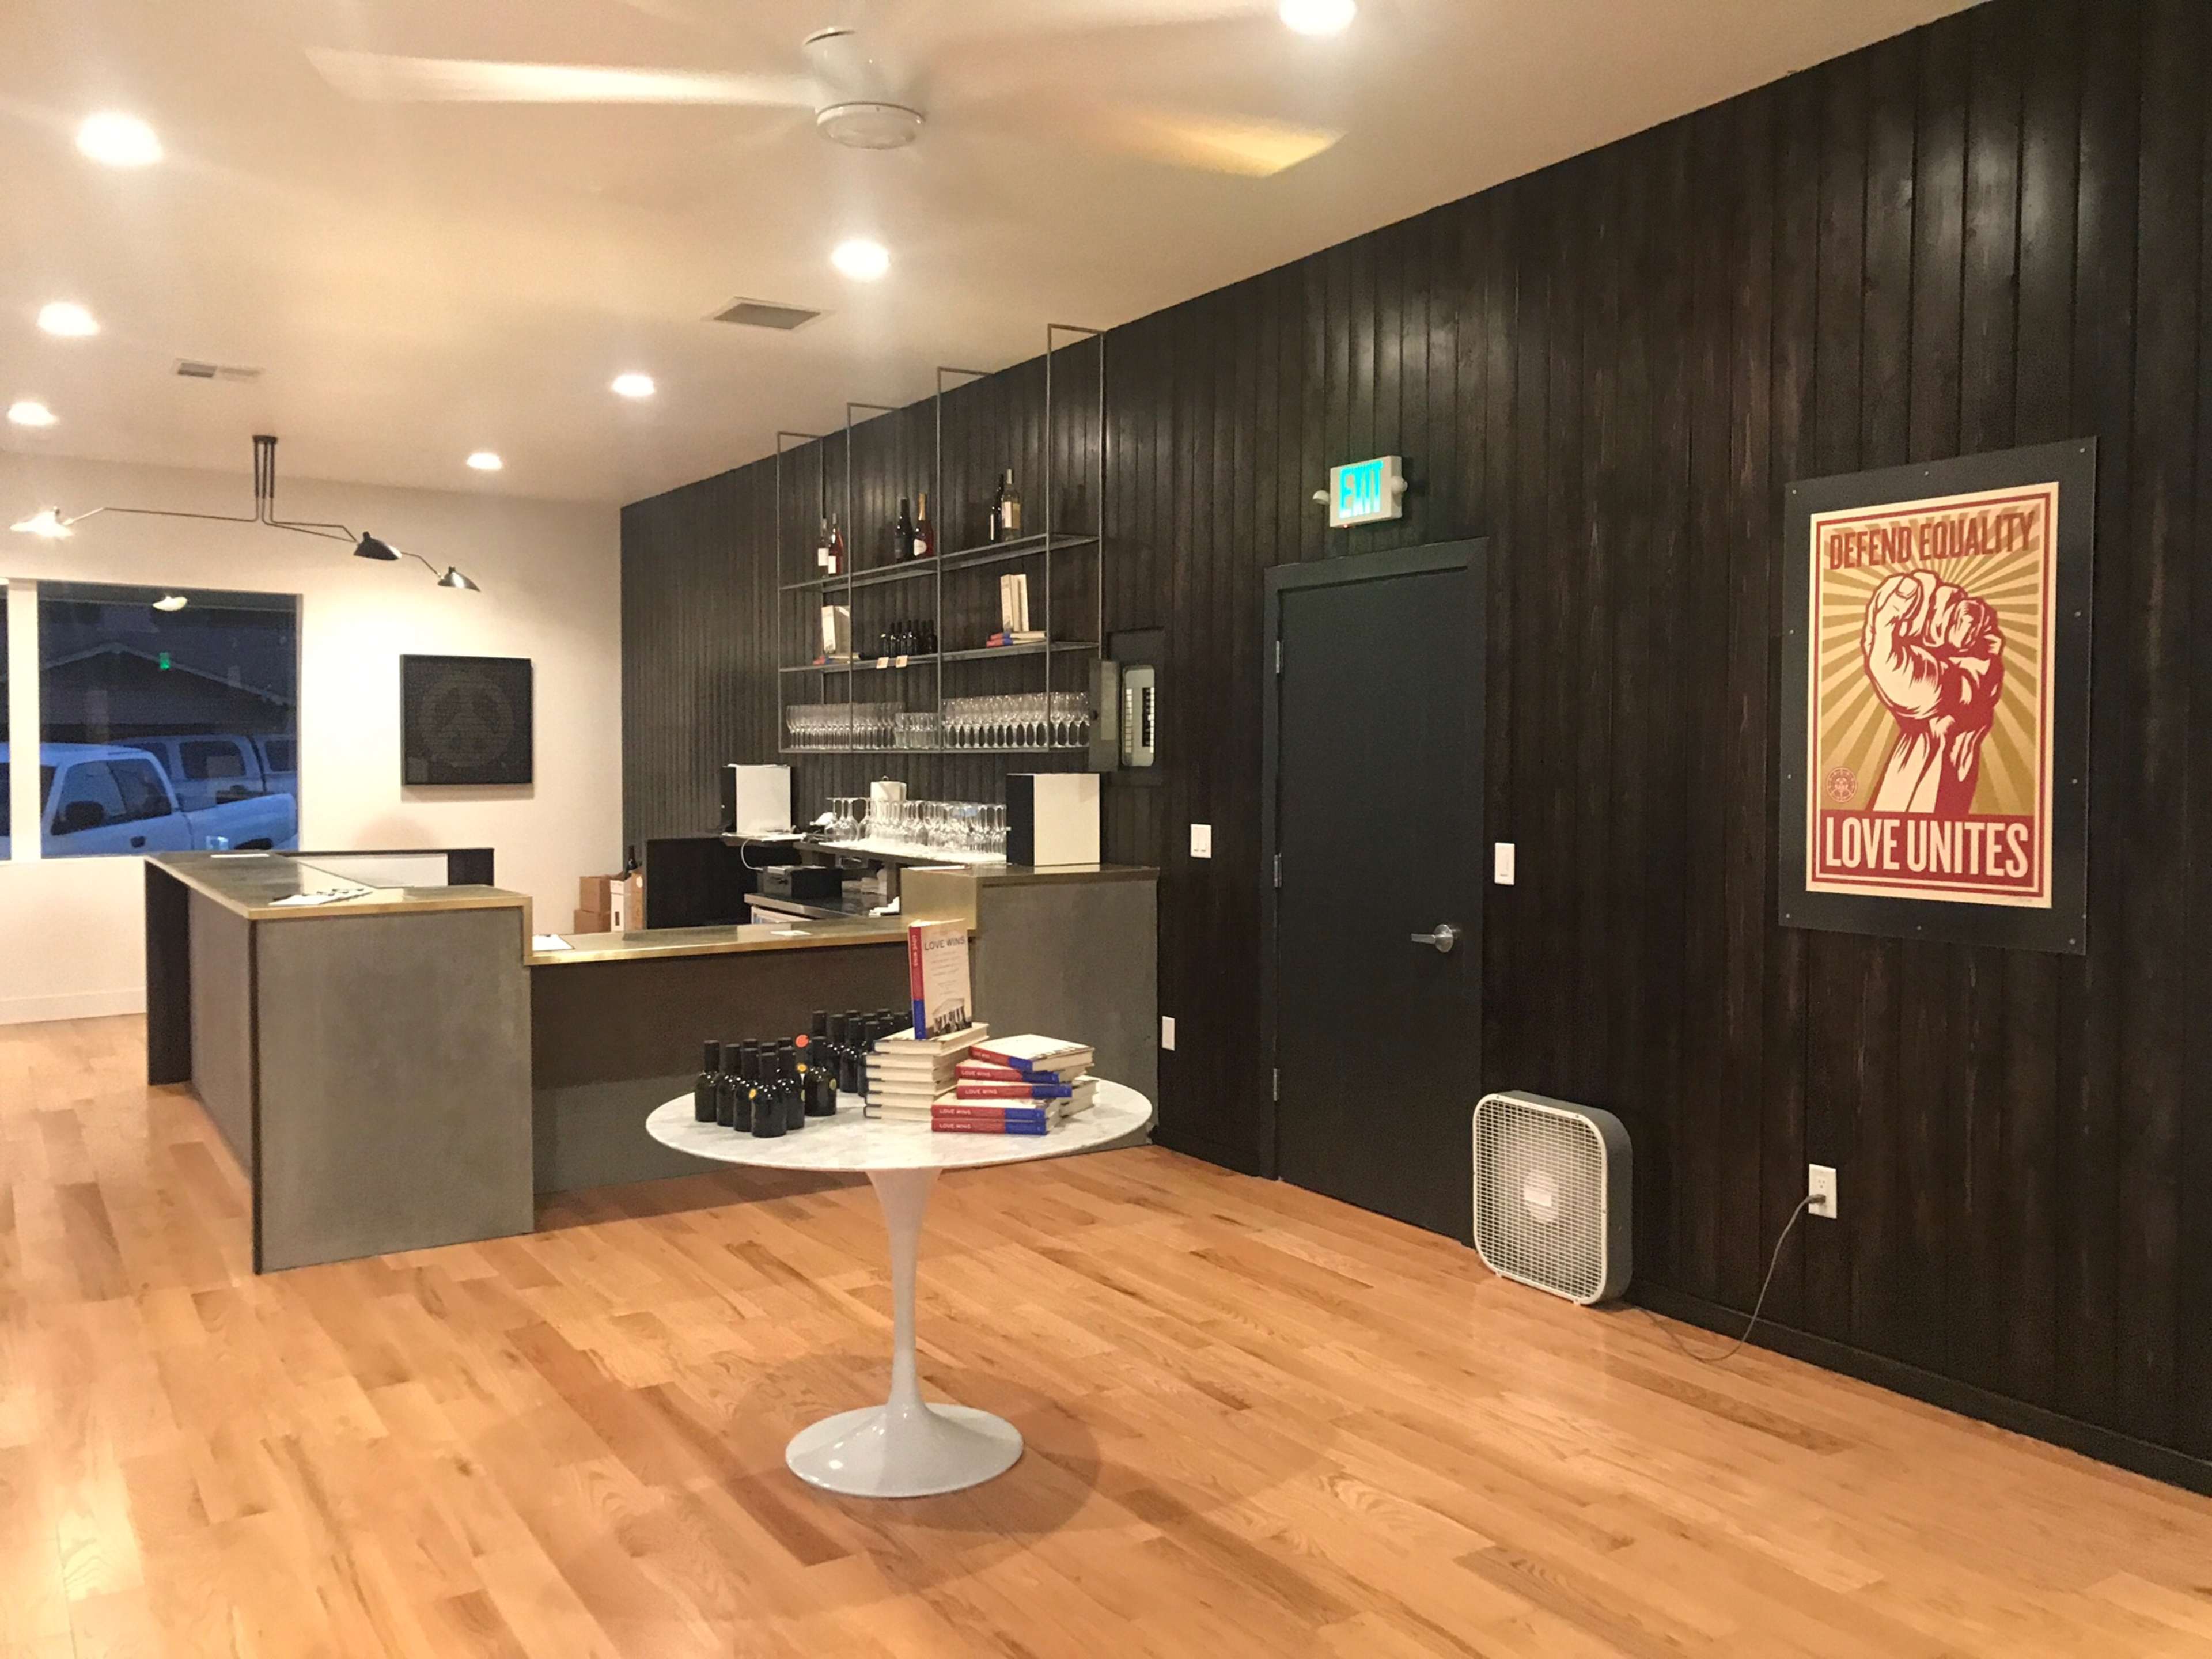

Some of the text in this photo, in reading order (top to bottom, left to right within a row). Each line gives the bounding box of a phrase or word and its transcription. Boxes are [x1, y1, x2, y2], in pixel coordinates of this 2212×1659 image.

[1339, 460, 1384, 519] EXIT
[1830, 510, 2036, 570] DEFEND EQUALITY
[1825, 817, 2028, 878] LOVE UNITES
[924, 935, 965, 951] LOVE WINS
